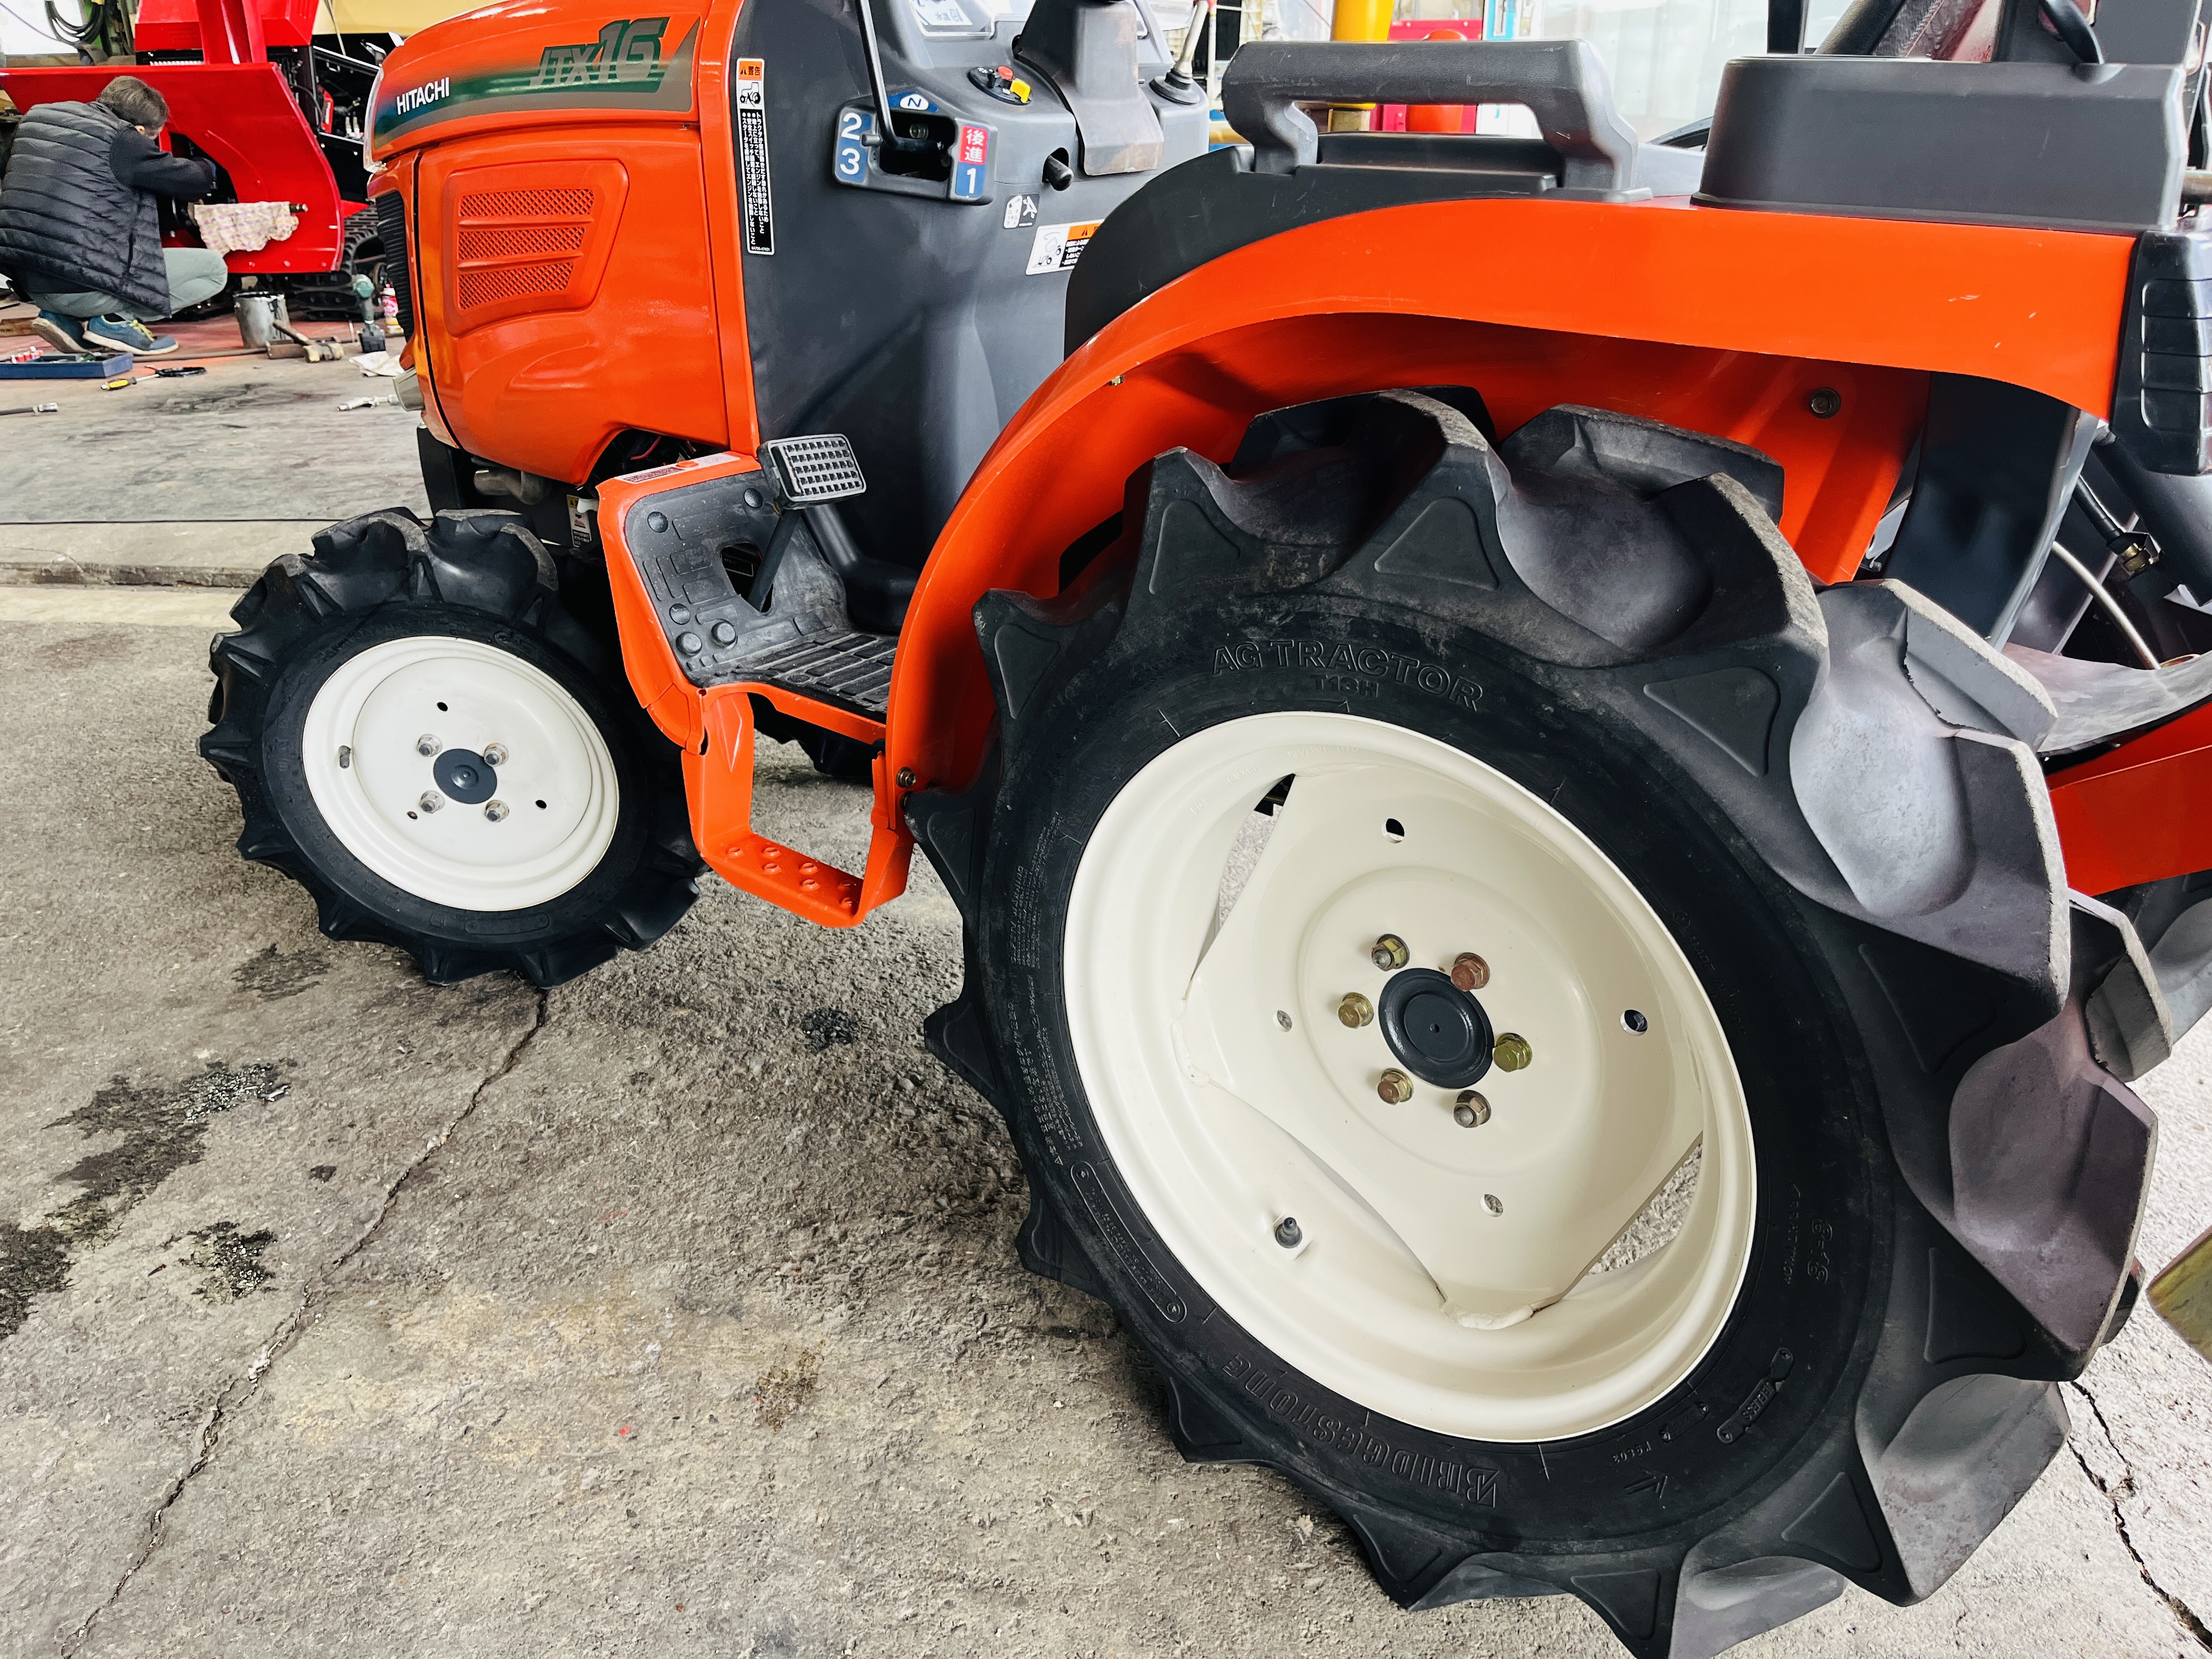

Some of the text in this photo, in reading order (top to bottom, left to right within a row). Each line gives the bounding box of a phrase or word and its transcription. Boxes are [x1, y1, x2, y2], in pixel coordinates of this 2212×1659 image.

[748, 66, 760, 75] 警告
[396, 77, 450, 115] HITACHI
[907, 97, 922, 108] N
[841, 112, 862, 140] 2
[963, 129, 985, 163] 後進
[840, 148, 860, 175] 3
[966, 168, 977, 194] 1
[1212, 640, 1482, 712] AG TRACTOR
[1222, 1353, 1499, 1508] BRIDGESTONE
